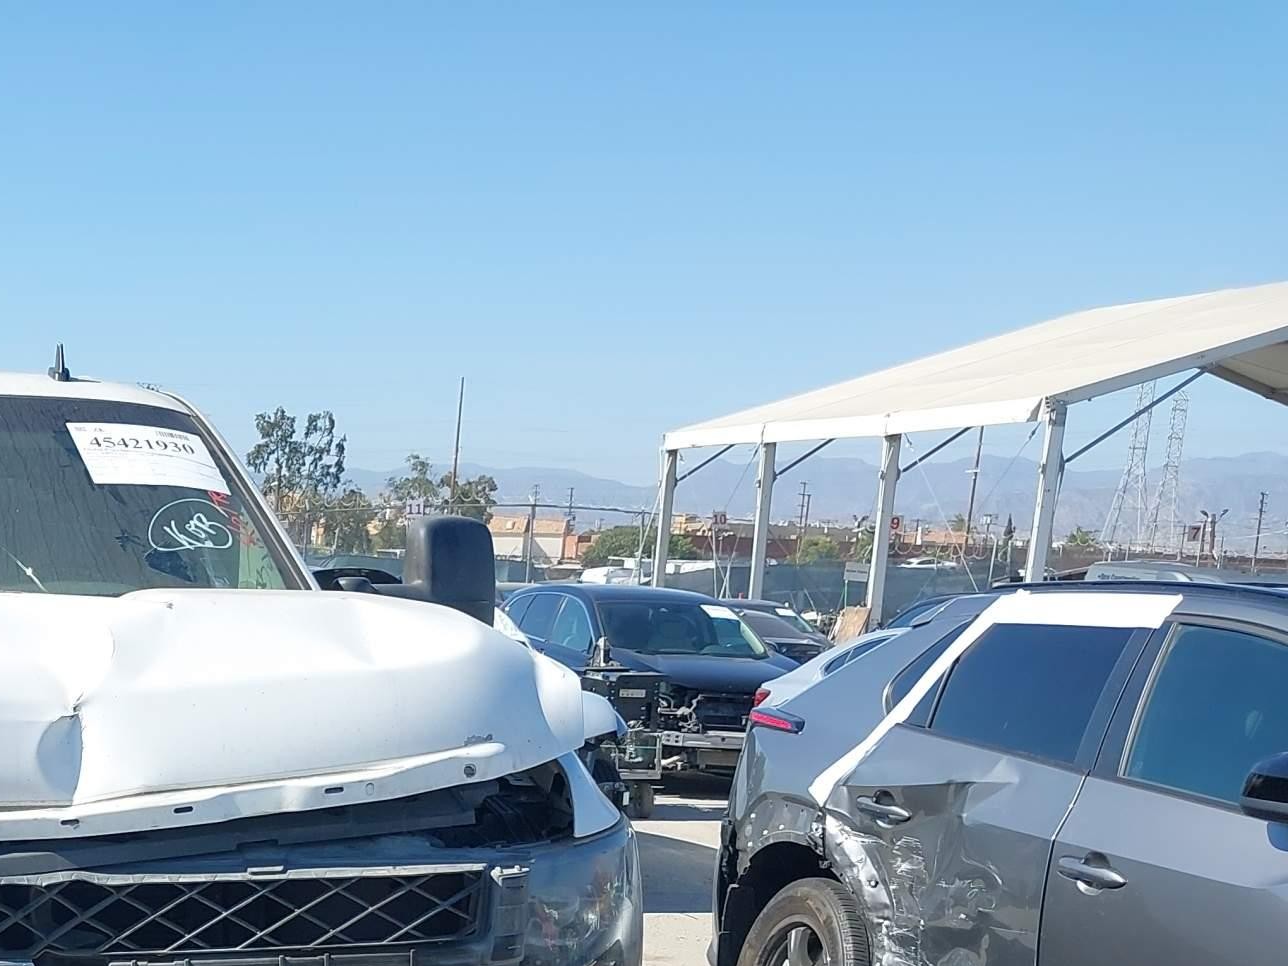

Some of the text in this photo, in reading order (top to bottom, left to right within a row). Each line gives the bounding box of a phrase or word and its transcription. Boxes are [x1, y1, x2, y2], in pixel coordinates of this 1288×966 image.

[90, 436, 196, 455] 45421930
[407, 503, 423, 515] 11
[712, 514, 727, 525] 10
[890, 516, 900, 529] 9
[1191, 527, 1201, 540] 7
